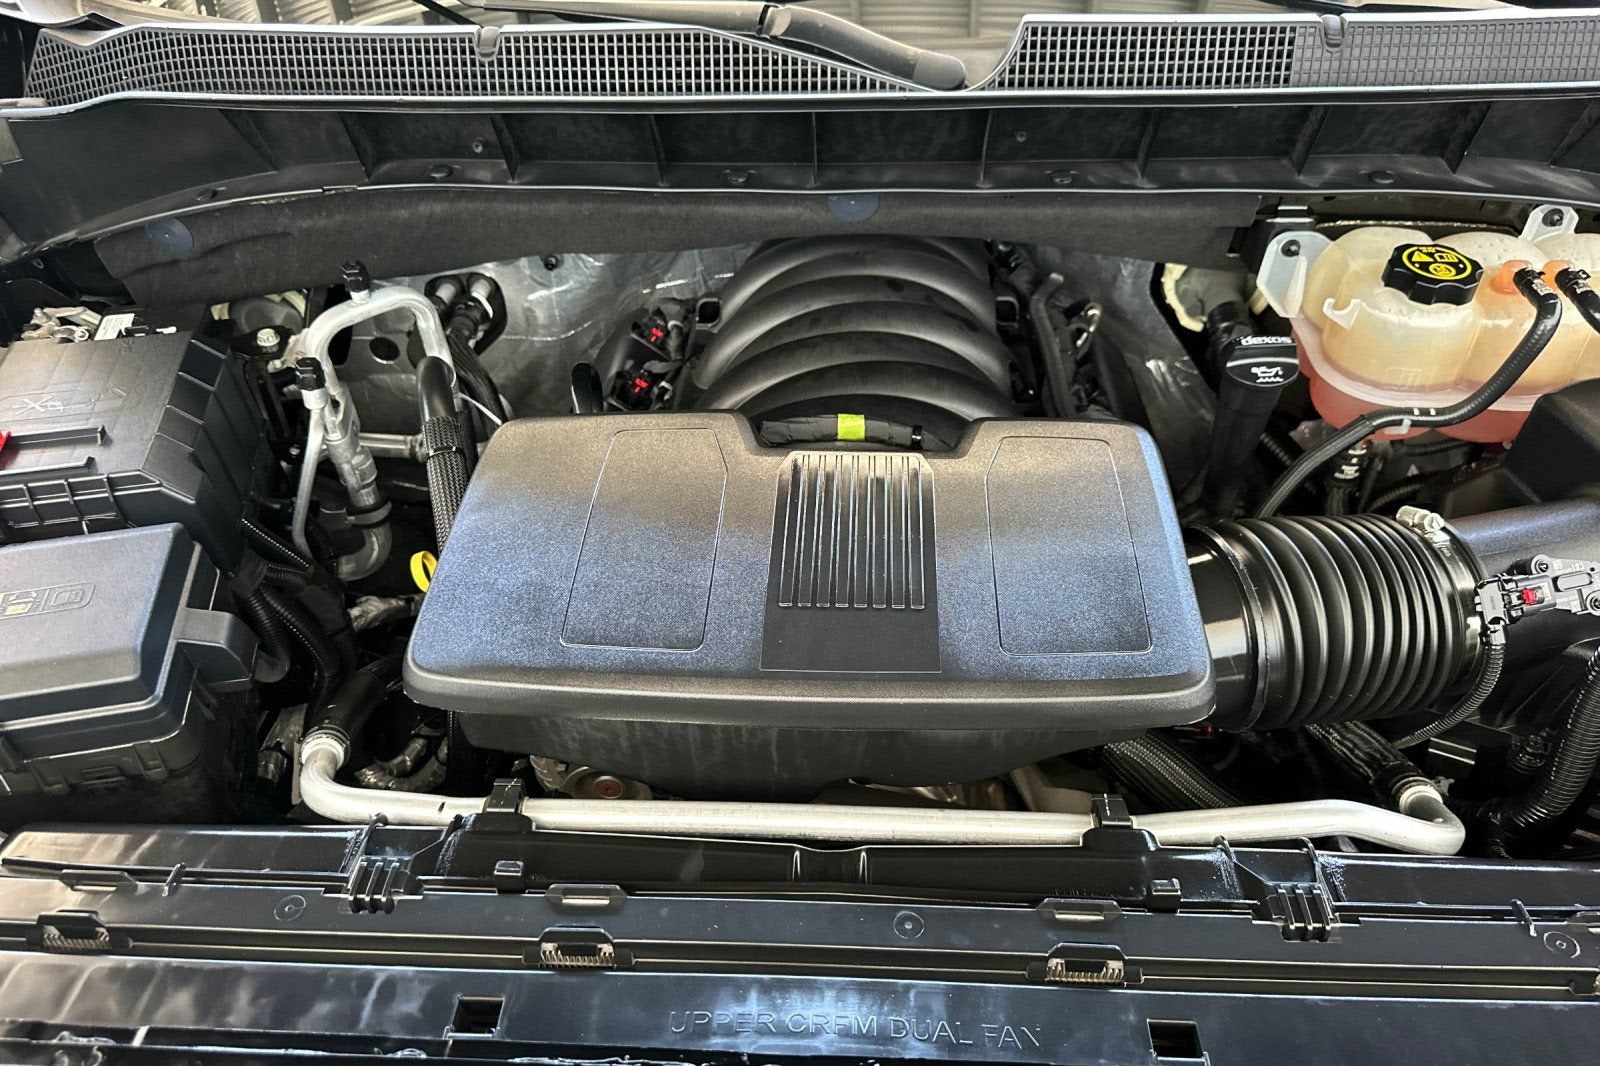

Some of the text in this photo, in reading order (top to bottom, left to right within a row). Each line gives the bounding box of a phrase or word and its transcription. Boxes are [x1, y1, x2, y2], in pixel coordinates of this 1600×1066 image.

[1241, 336, 1292, 345] dexos
[669, 1011, 1041, 1049] UPPER CRFM DUAL FAN
